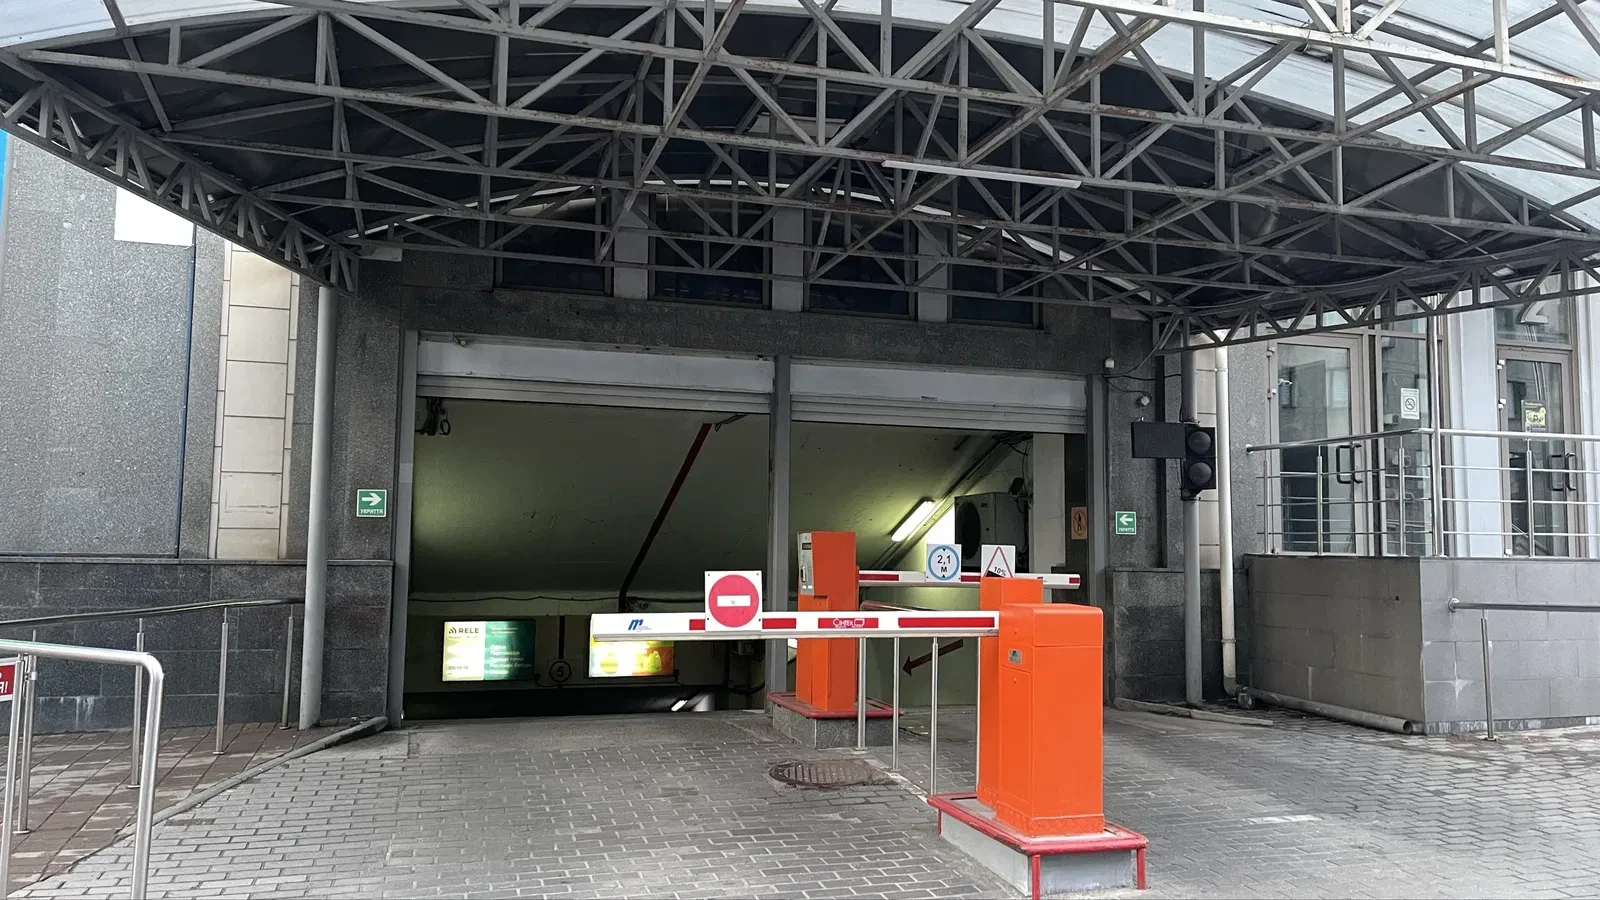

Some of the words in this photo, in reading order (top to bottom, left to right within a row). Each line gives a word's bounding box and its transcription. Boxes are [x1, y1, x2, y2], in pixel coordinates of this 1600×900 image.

[937, 554, 951, 565] 2,1
[993, 566, 1007, 577] 10%
[556, 666, 565, 678] 5
